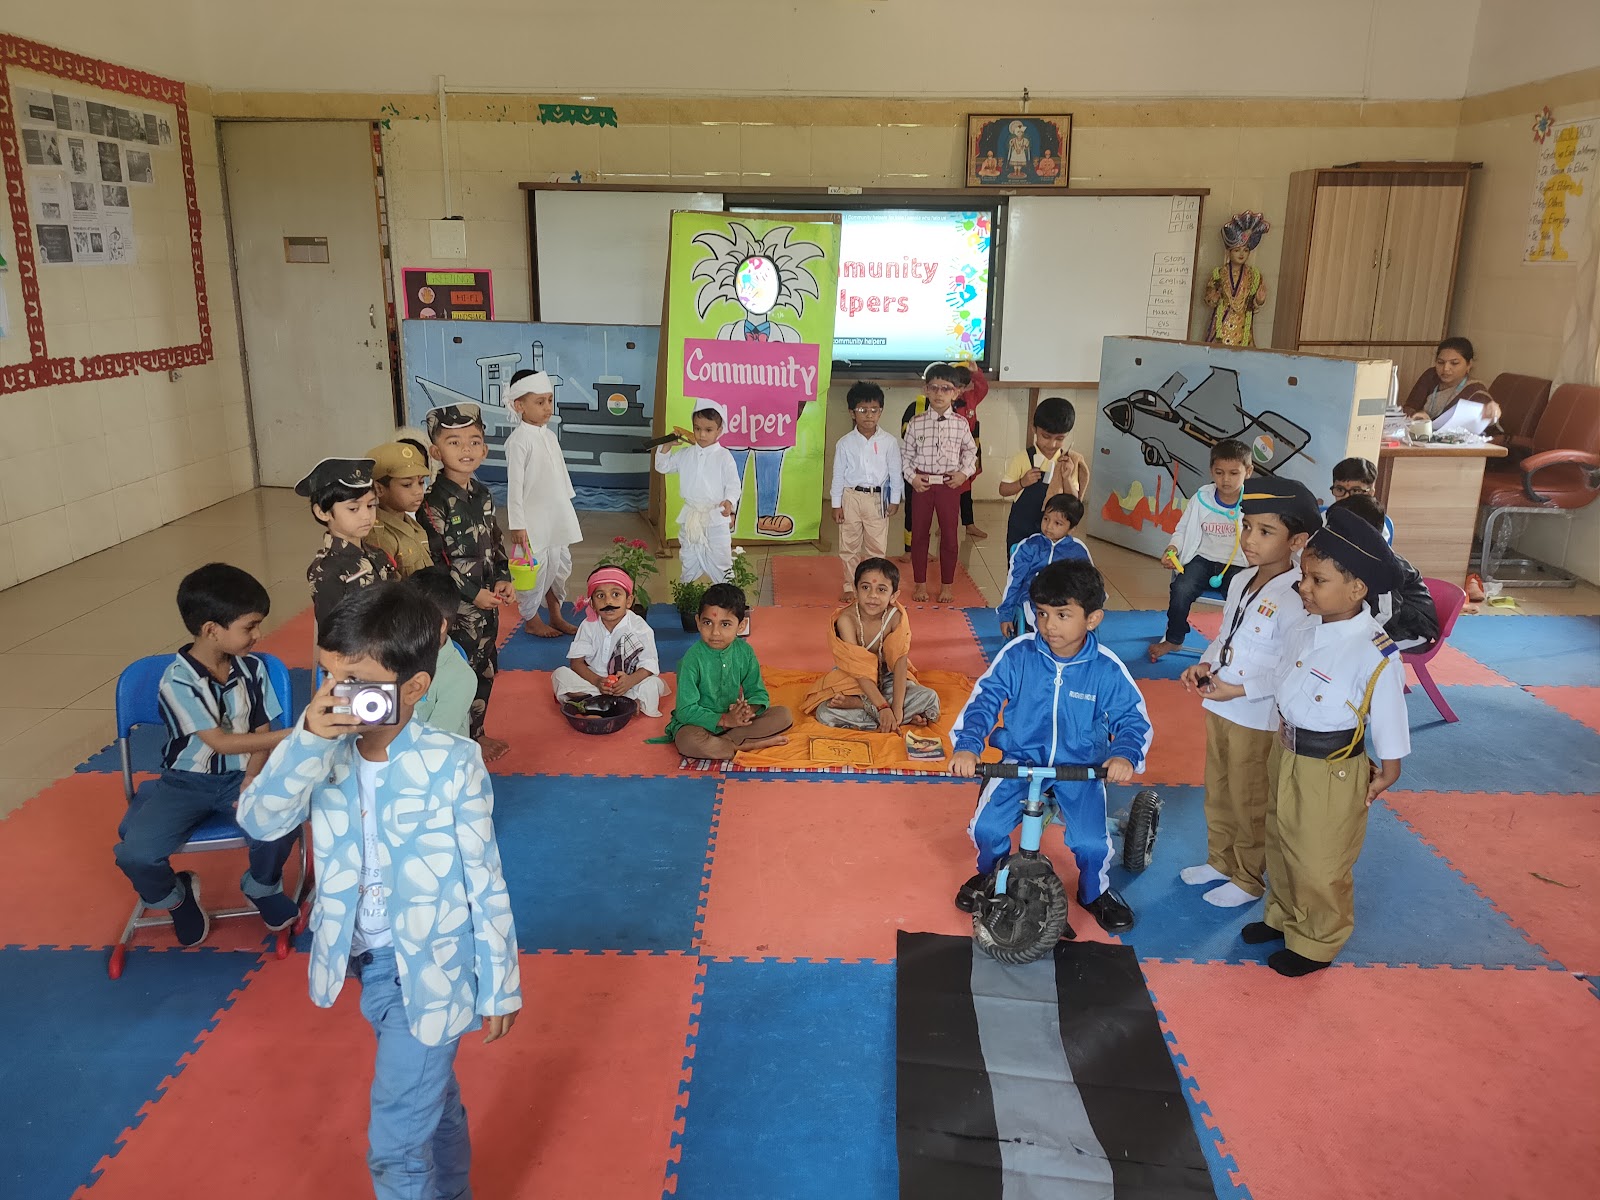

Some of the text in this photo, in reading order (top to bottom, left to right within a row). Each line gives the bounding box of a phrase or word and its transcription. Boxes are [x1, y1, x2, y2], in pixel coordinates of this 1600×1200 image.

[1177, 200, 1183, 209] P
[1174, 213, 1181, 221] A
[1163, 256, 1186, 265] Story
[838, 255, 939, 284] munity
[1158, 277, 1187, 285] English
[456, 294, 479, 302] HI-FI
[839, 288, 909, 317] lpers
[864, 337, 886, 346] helpers
[686, 347, 817, 396] Community
